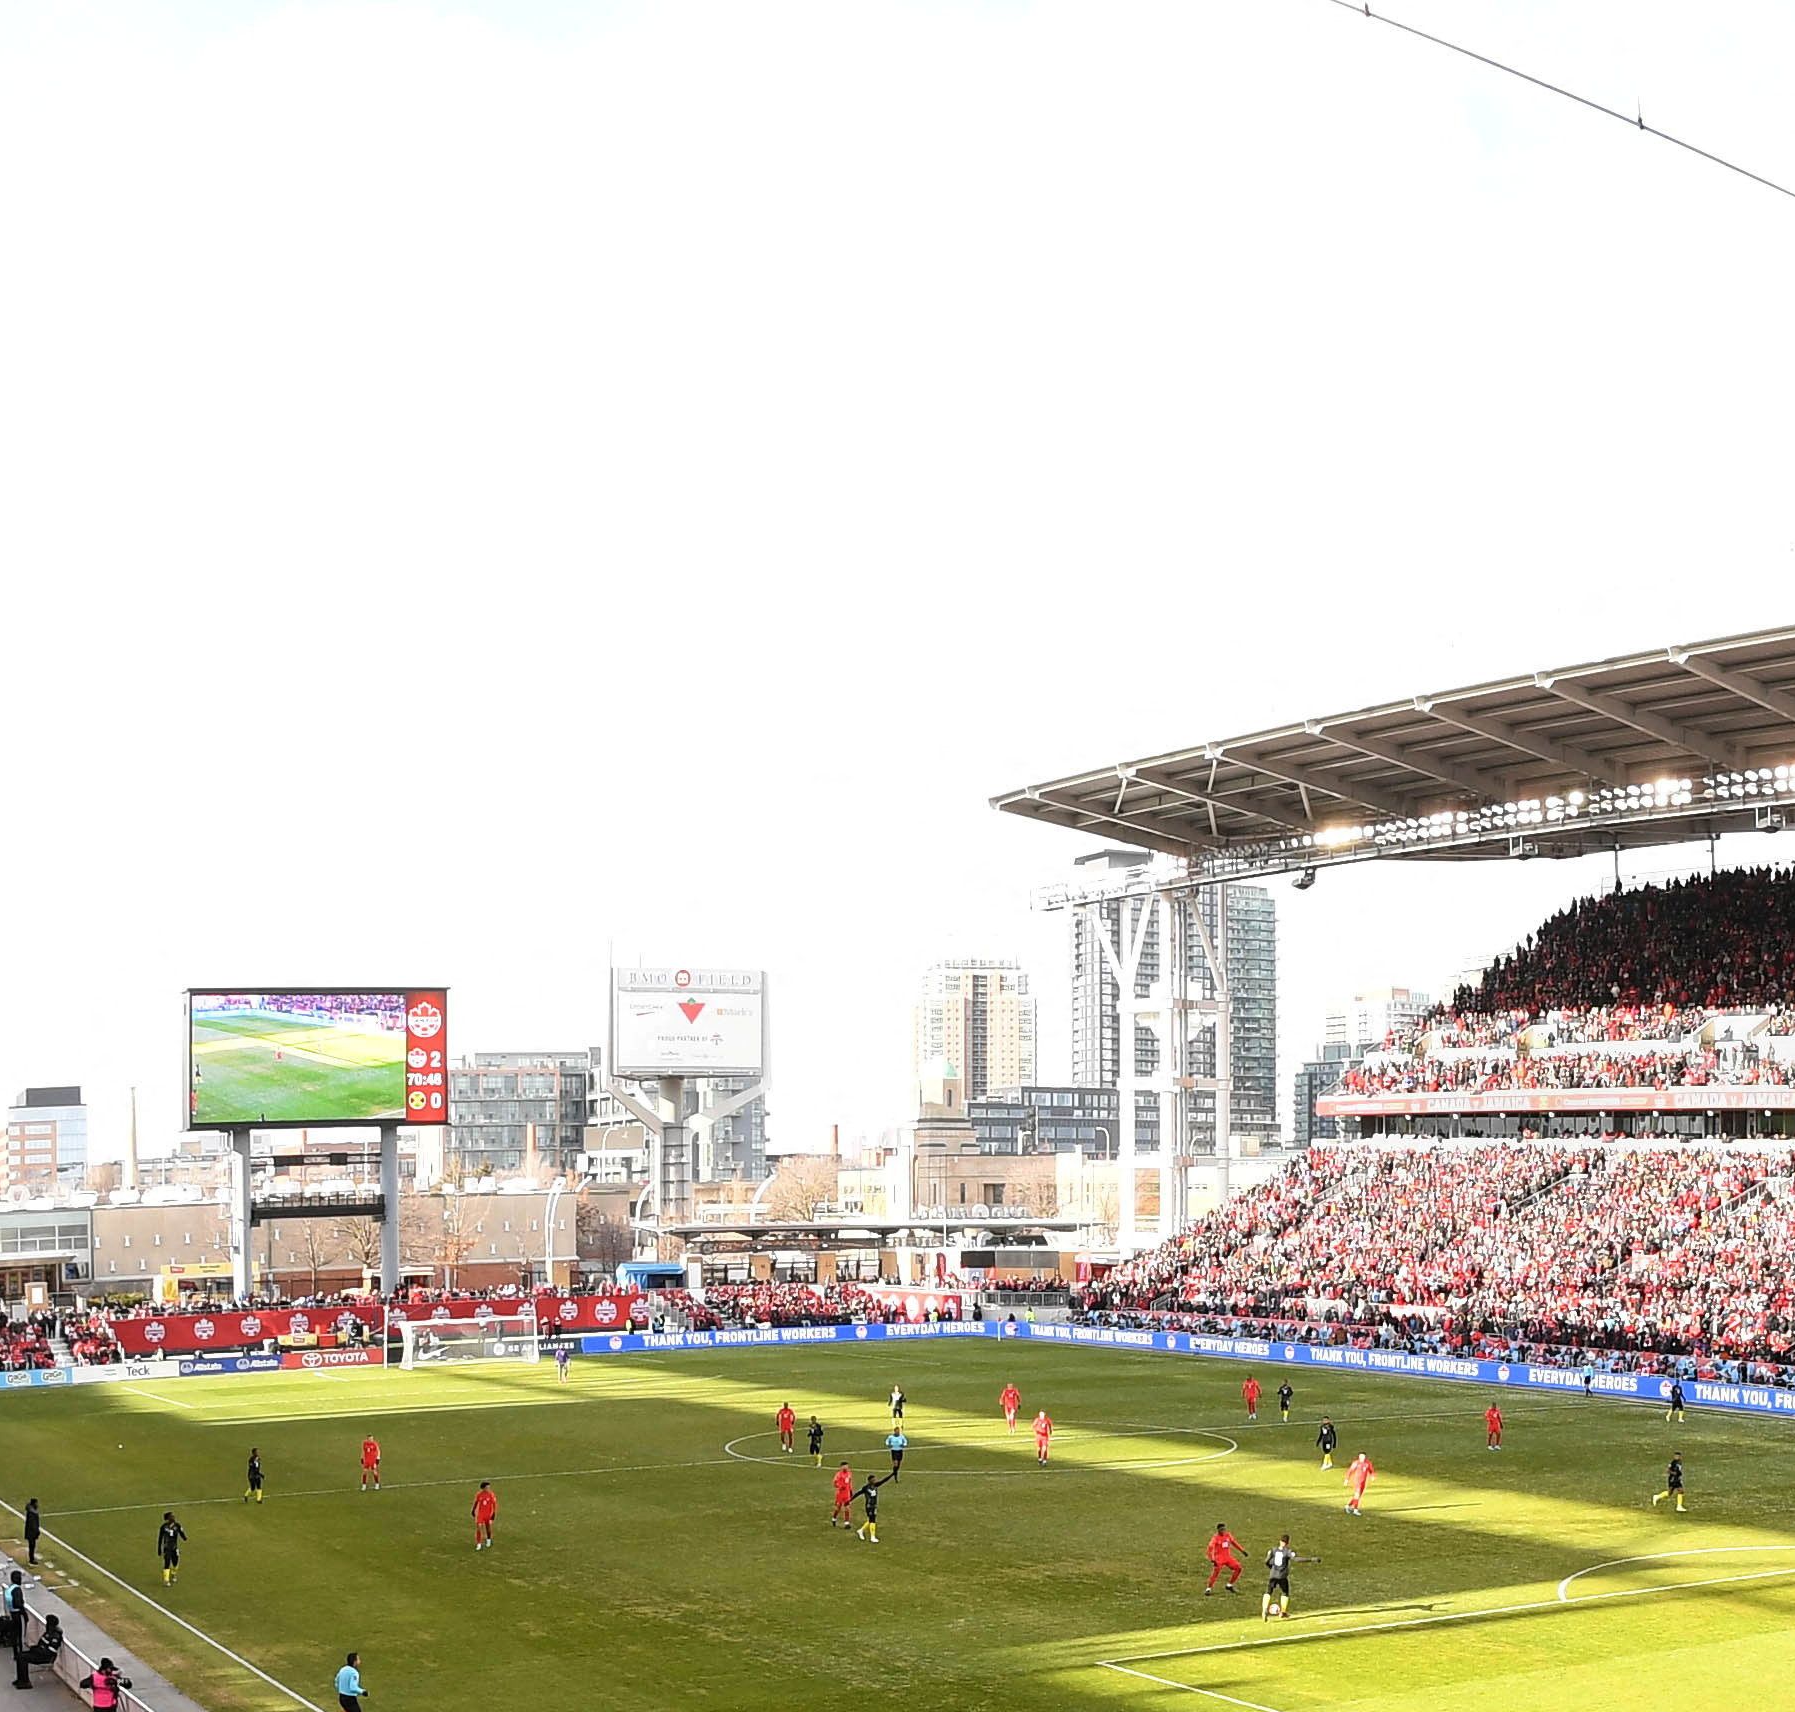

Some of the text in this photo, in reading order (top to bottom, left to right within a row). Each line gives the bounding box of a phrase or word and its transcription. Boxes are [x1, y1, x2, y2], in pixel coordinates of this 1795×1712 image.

[629, 972, 752, 986] BMO FIELD
[429, 1050, 442, 1068] 2
[430, 1091, 442, 1109] 0
[643, 1327, 837, 1347] THANK YOU, FRONTLINE WORKERS
[886, 1321, 985, 1336] EVERYDAY HEROES
[1029, 1324, 1153, 1346] THANK YOU, FRONTLINE WORKERS
[1235, 1341, 1270, 1356] HEROES
[322, 1352, 369, 1364] TOYOTA
[1310, 1347, 1479, 1377] THANK YOU, FRONTLINE WORKERS
[125, 1364, 151, 1377] Teck
[1589, 1374, 1638, 1392] HEROES
[1694, 1383, 1740, 1405] THANK
[1741, 1388, 1772, 1409] YOU,
